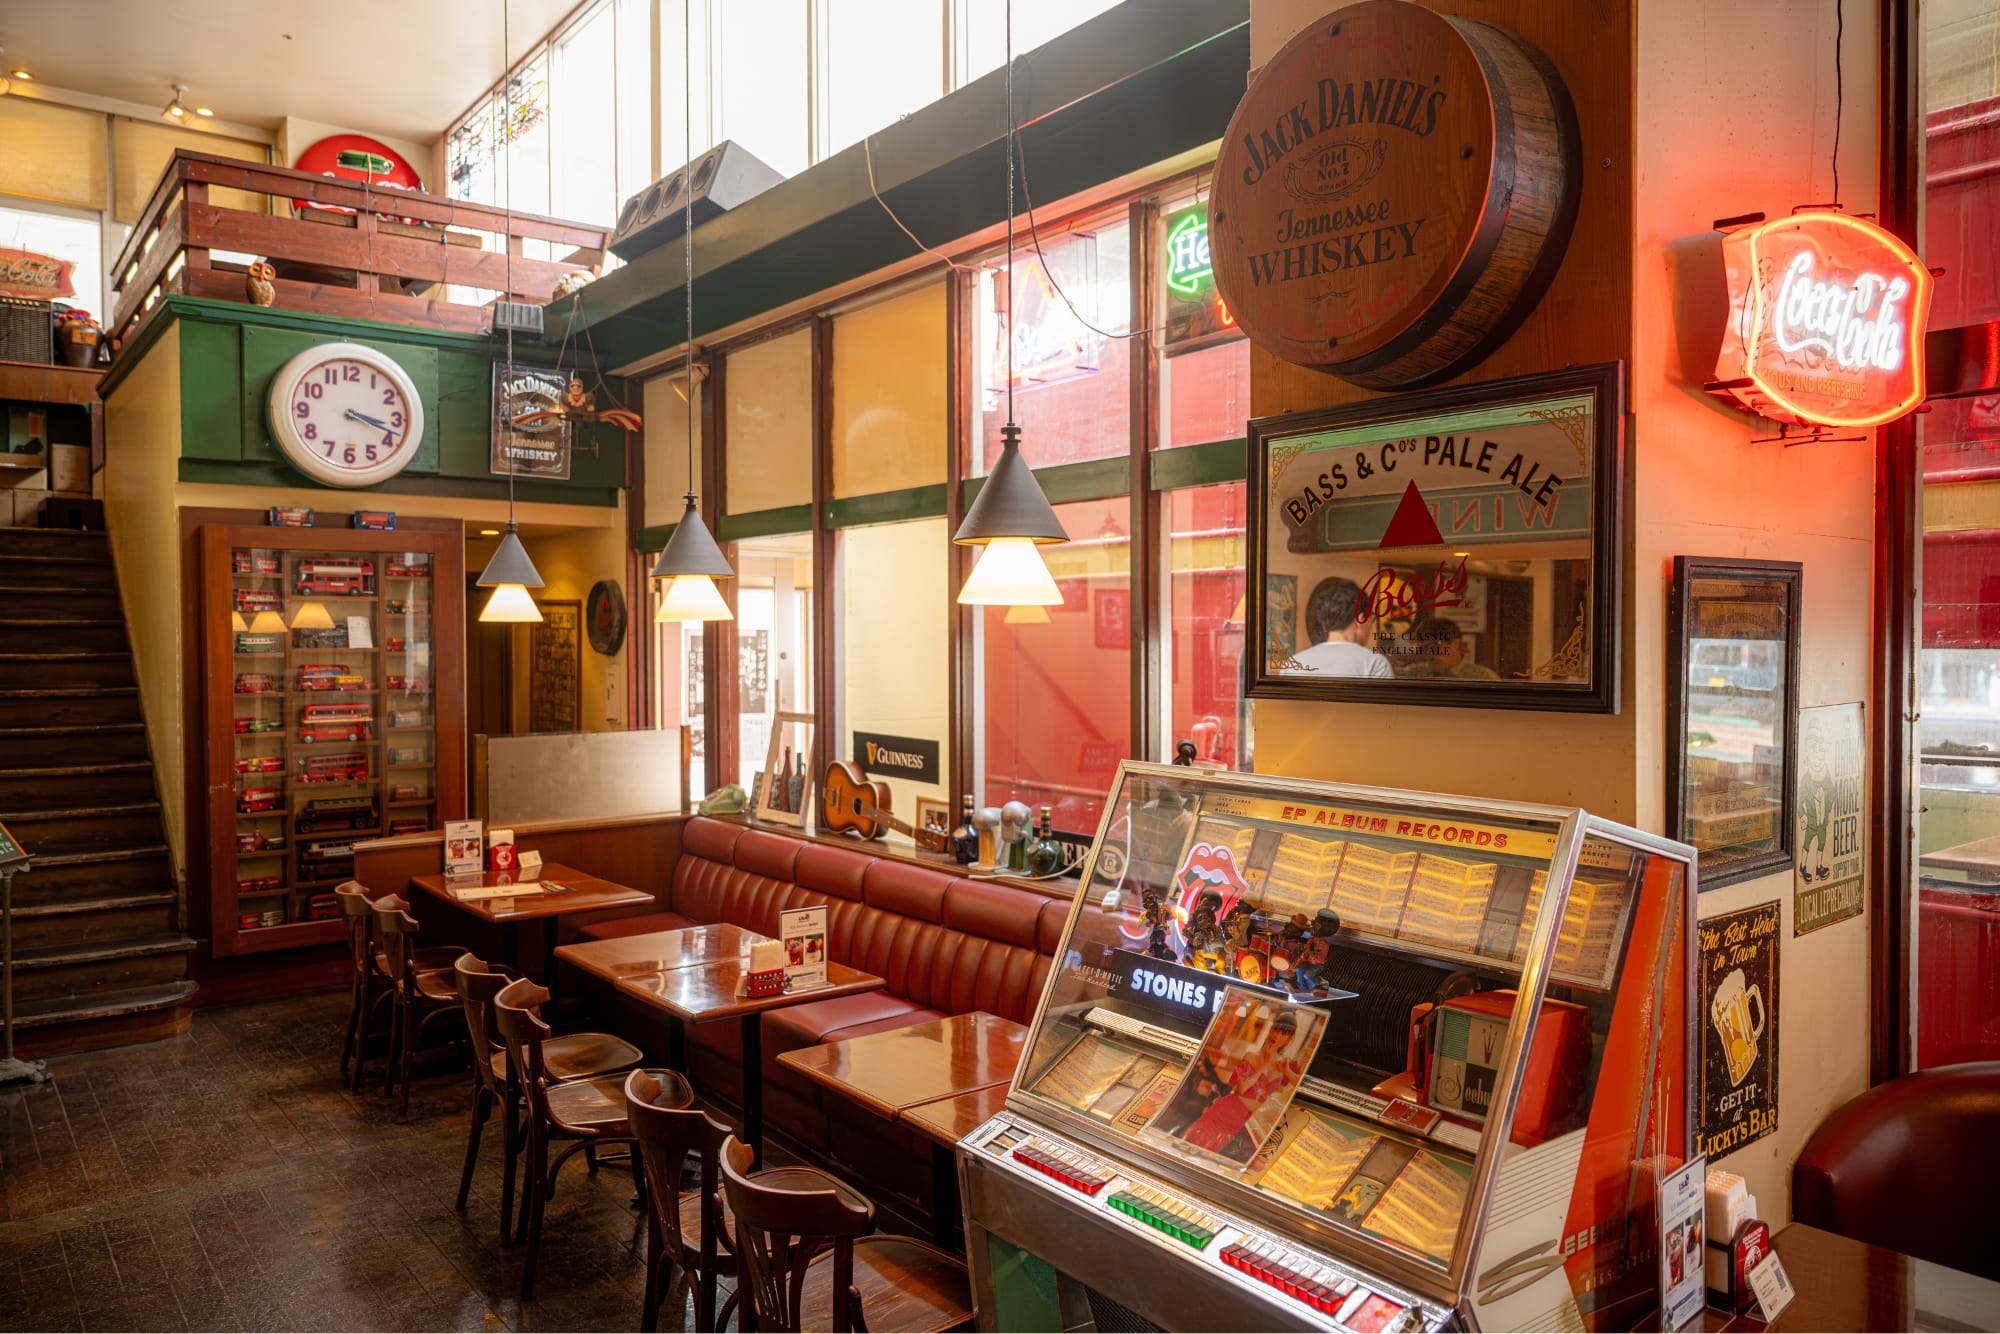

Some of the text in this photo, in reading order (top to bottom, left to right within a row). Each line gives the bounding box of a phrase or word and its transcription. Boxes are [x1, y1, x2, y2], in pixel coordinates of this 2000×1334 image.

[1241, 75, 1448, 186] JACK DANIEL'S
[1320, 148, 1347, 167] Old
[1276, 199, 1391, 244] Tennessee
[1248, 218, 1427, 288] WHISKEY
[325, 368, 337, 385] 11
[343, 365, 360, 382] 12
[370, 373, 376, 389] 1
[1793, 373, 1815, 393] AND
[304, 382, 323, 399] 10
[383, 389, 395, 405] 2
[296, 402, 310, 418] 9
[391, 411, 402, 428] 3
[304, 423, 317, 440] 8
[381, 432, 393, 448] 4
[322, 440, 335, 457] 7
[343, 448, 356, 464] 6
[365, 444, 377, 461] 5
[505, 447, 558, 461] WHISKEY
[1285, 463, 1348, 526] BASS
[1355, 451, 1374, 480] &
[1423, 435, 1498, 474] PALE
[1499, 452, 1563, 507] ALE
[1354, 555, 1469, 624] Bass
[1372, 631, 1451, 642] THE CLASSIC
[1372, 646, 1451, 655] ENGLISH ALE
[877, 747, 924, 769] GUINNESS
[1834, 735, 1861, 778] DRINK
[1834, 776, 1860, 817] MORE
[1281, 806, 1508, 849] EP ALBUM RECORDS
[1833, 815, 1860, 858] BEER.
[1799, 893, 1819, 924] LOCAL
[1724, 921, 1748, 947] Best
[1750, 911, 1777, 938] Head
[1713, 952, 1725, 972] in
[1130, 968, 1207, 1009] STONES
[1720, 1083, 1757, 1113] GET IT
[1733, 1105, 1743, 1122] at
[1696, 1108, 1776, 1156] LUCKY'S BAR
